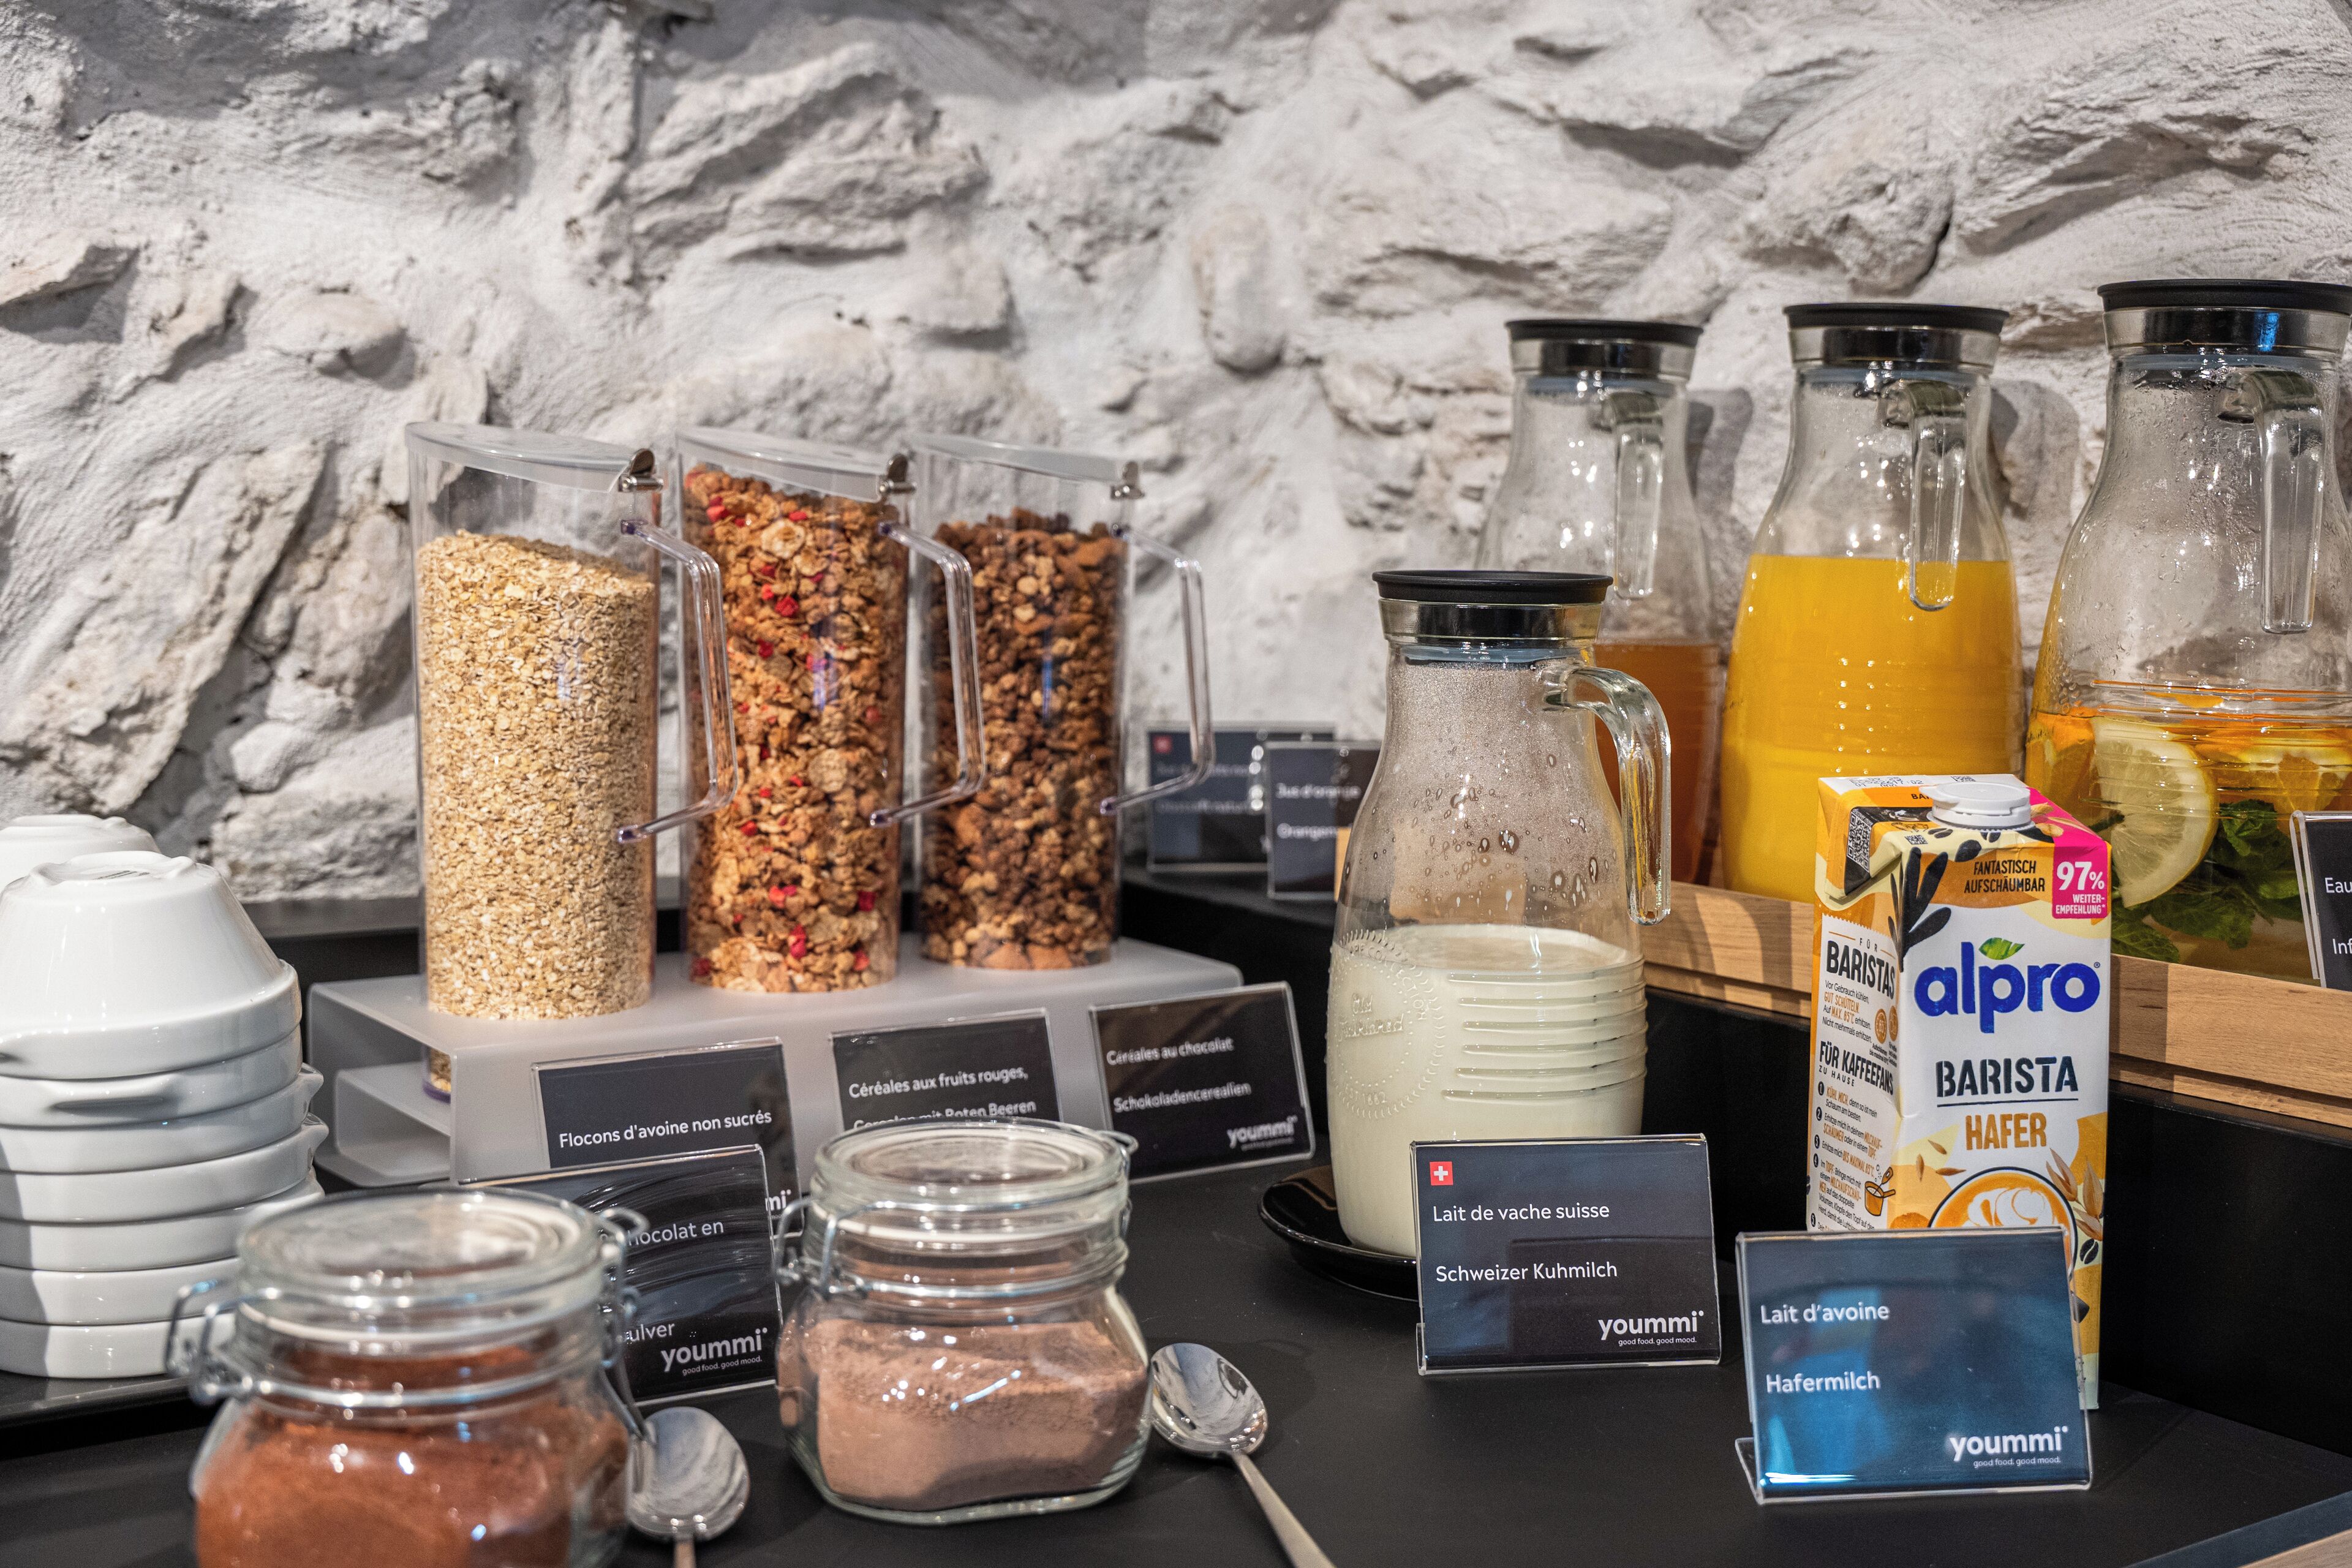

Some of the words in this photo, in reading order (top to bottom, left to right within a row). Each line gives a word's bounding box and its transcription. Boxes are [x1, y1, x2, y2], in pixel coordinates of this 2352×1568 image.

[1276, 823, 1337, 842] Orangen
[1973, 859, 2037, 876] FANTASTISCH
[2056, 861, 2105, 891] 97%
[1964, 876, 2046, 894] AUFSCHÄUMBAR
[2073, 894, 2105, 905] WEITER-
[1859, 938, 1878, 952] FÜR
[2332, 938, 2352, 954] Inf
[1826, 940, 1896, 1000] BARISTAS
[1824, 991, 1834, 1003] GUT
[1825, 980, 1833, 990] Vor
[1834, 983, 1855, 997] Gebrauch
[1823, 1005, 1831, 1013] Auf
[1831, 1006, 1842, 1019] MAX.
[1844, 1010, 1855, 1024] 65°C
[1855, 1017, 1871, 1030] erhitzen.
[1822, 1016, 1834, 1028] Nicht
[1834, 1022, 1855, 1036] mehrmals
[1855, 1030, 1872, 1044] erhitzen.
[1107, 1046, 1161, 1065] Céréales
[1161, 1047, 1178, 1060] au
[1178, 1036, 1234, 1057] chocolat
[1819, 1041, 1839, 1069] FÜR
[1841, 1049, 1893, 1095] KAFFEEFANS
[1819, 1065, 1827, 1074] ZU
[1831, 1071, 1855, 1087] HAUSE
[1936, 1056, 2078, 1097] BARISTA
[849, 1079, 910, 1098] Céréales
[912, 1077, 937, 1091] aux
[938, 1071, 976, 1088] fruits
[979, 1066, 1028, 1084] rouges,
[1826, 1086, 1837, 1100] KÜHL
[989, 1101, 1036, 1116] Beeren
[1825, 1099, 1841, 1112] Schaum
[1841, 1107, 1848, 1115] am
[559, 1130, 620, 1148] Flocons
[624, 1120, 688, 1141] d'avoine
[692, 1118, 722, 1133] non
[724, 1110, 772, 1128] sucrés
[1825, 1112, 1837, 1125] Erhitze
[1837, 1120, 1847, 1130] mich
[1965, 1112, 2046, 1150] HAFER
[1433, 1205, 1466, 1222] Lait
[1471, 1204, 1494, 1221] de
[1498, 1204, 1551, 1221] vache
[1556, 1203, 1610, 1219] suisse
[628, 1224, 701, 1246] hocolat
[703, 1220, 725, 1235] en
[1436, 1264, 1528, 1282] Schweizer
[1533, 1261, 1618, 1280] Kuhmilch
[1761, 1304, 1798, 1324] Lait
[1803, 1302, 1890, 1323] d’avoine
[628, 1323, 676, 1342] ulver
[682, 1366, 701, 1376] good
[701, 1362, 720, 1371] food.
[721, 1360, 739, 1370] good
[740, 1355, 763, 1365] mood.
[1766, 1371, 1881, 1394] Hafermilch
[1973, 1459, 1993, 1469] good
[1994, 1457, 2015, 1468] food.
[2016, 1457, 2035, 1467] good
[2037, 1456, 2061, 1466] mood.
